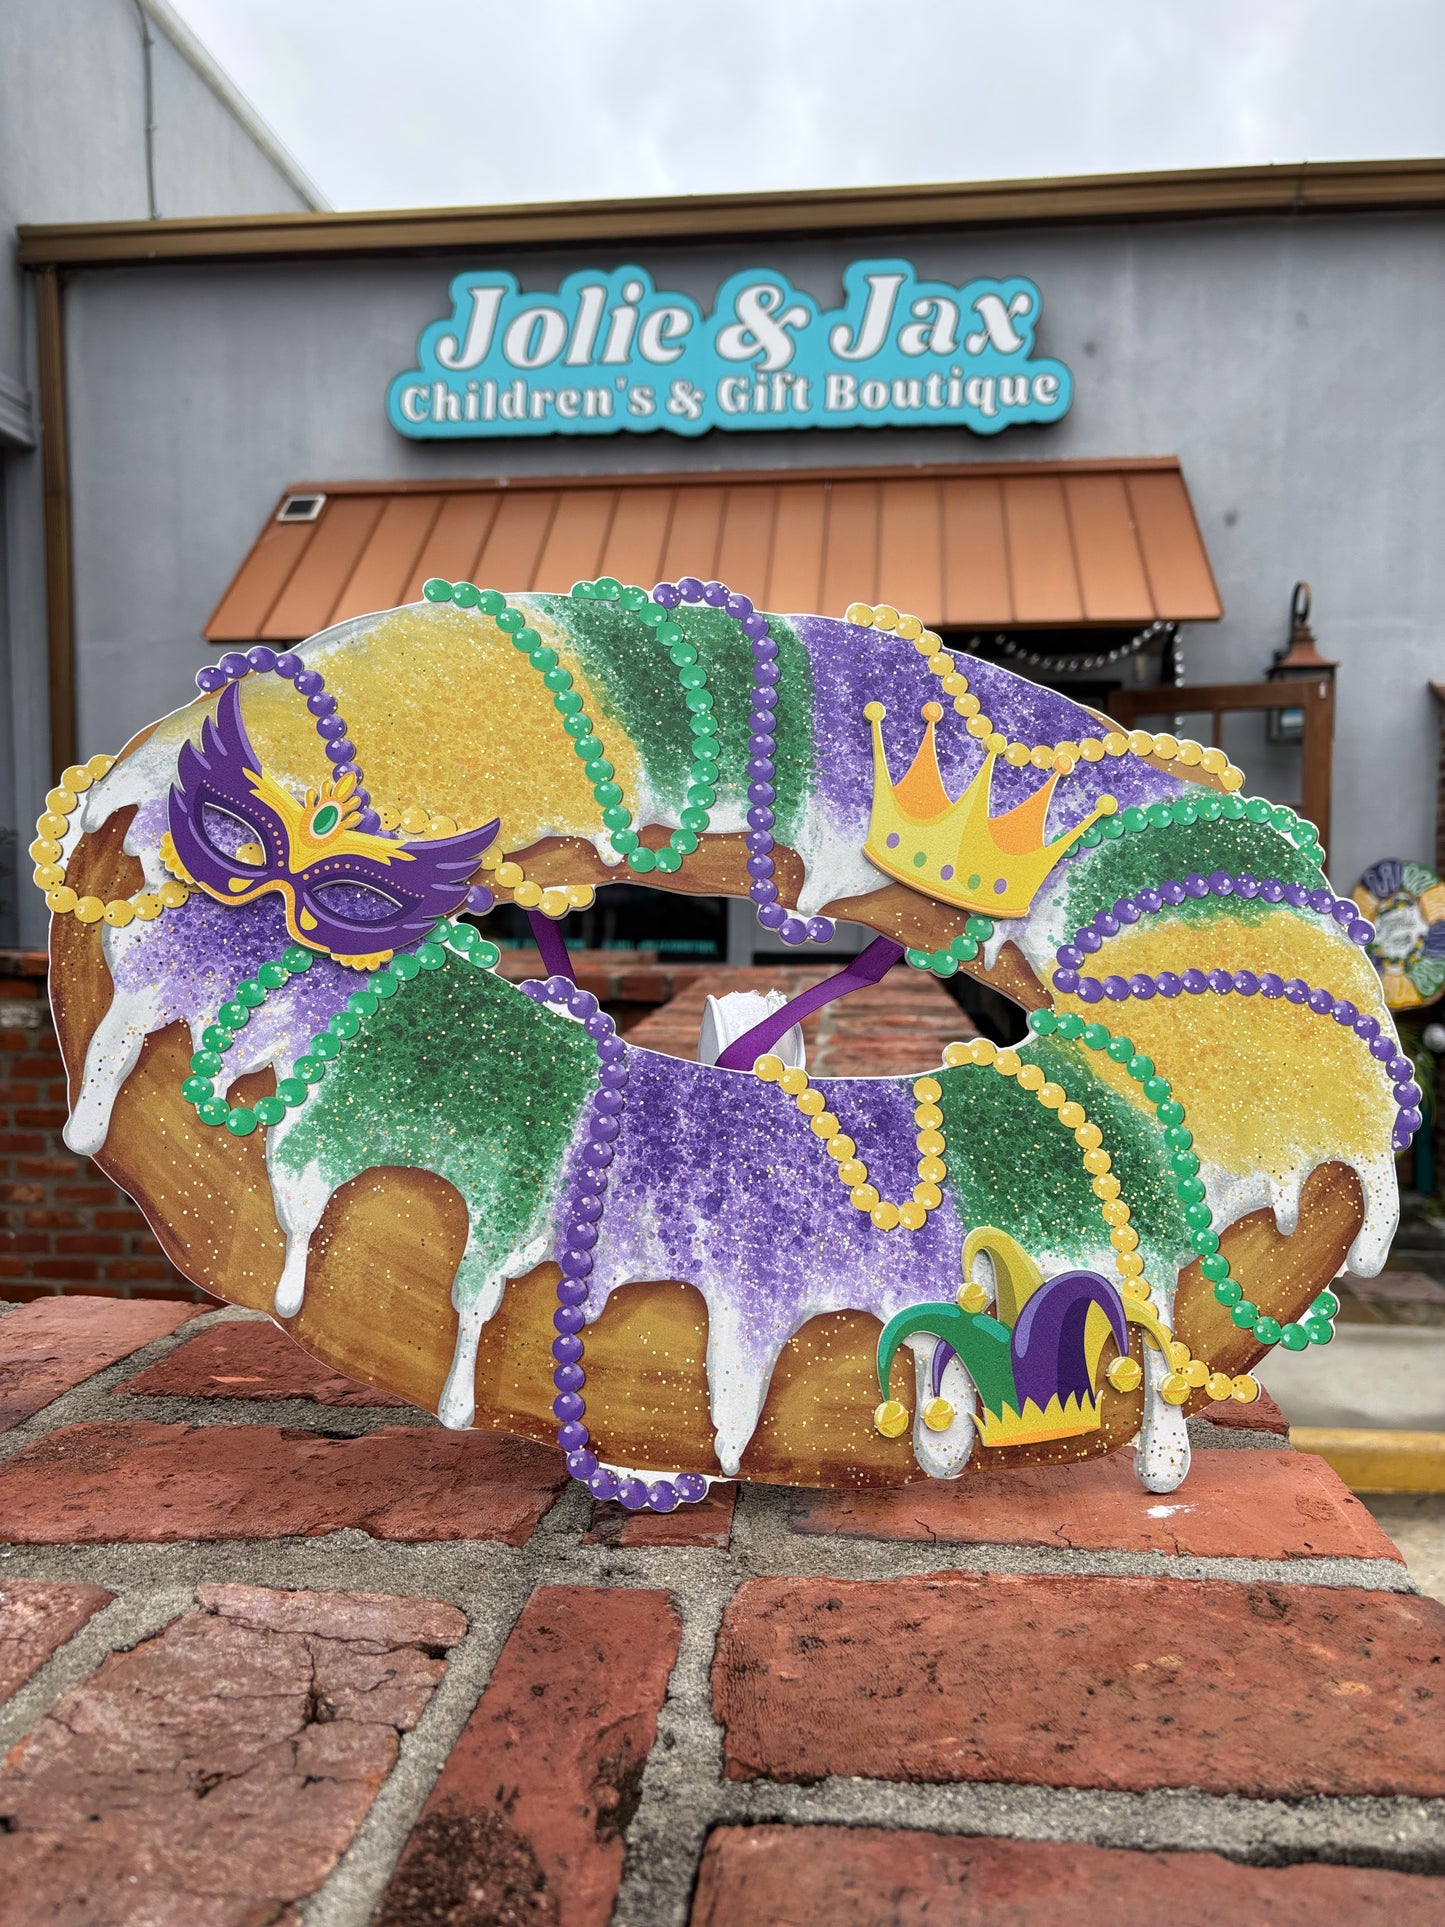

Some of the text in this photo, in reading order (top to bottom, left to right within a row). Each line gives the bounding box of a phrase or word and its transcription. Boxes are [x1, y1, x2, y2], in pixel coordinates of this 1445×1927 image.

[436, 273, 1032, 371] Jolie & Jax
[402, 365, 1060, 422] Children's & Gift Boutique
